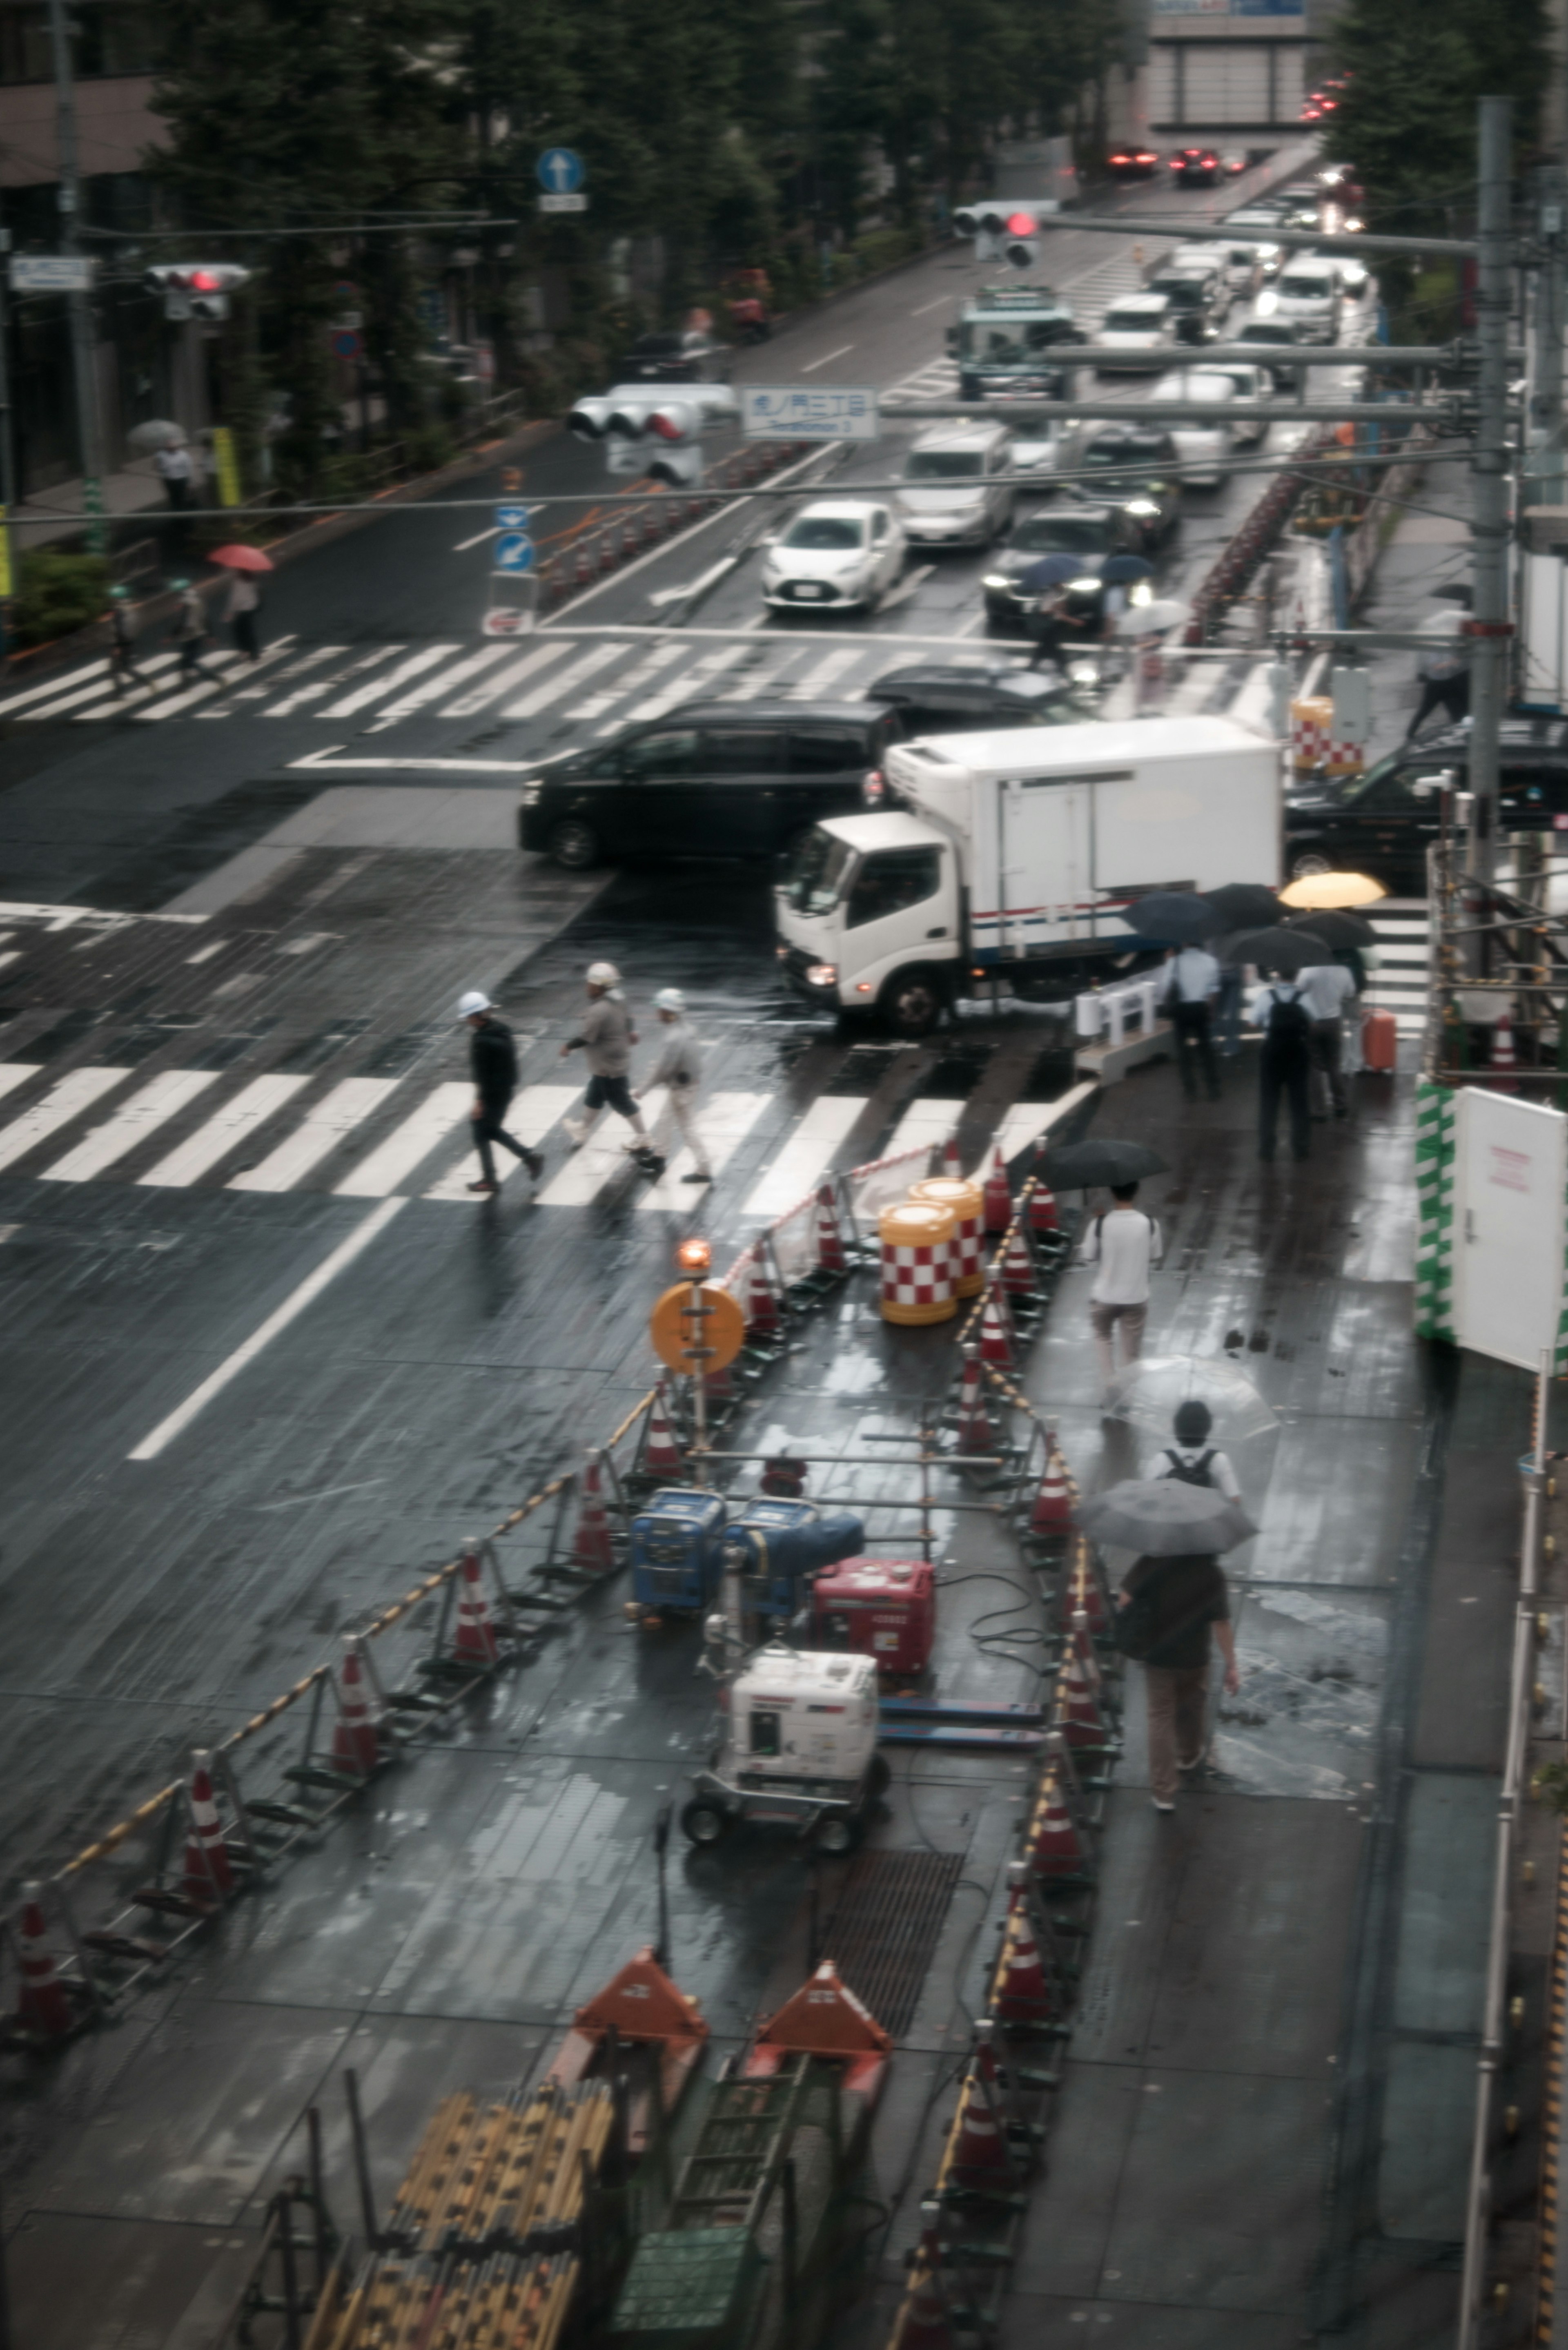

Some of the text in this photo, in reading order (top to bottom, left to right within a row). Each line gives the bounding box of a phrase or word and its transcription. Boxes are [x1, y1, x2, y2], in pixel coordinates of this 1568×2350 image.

[753, 395, 864, 416] 虎ノ門三丁目
[843, 420, 851, 433] 3
